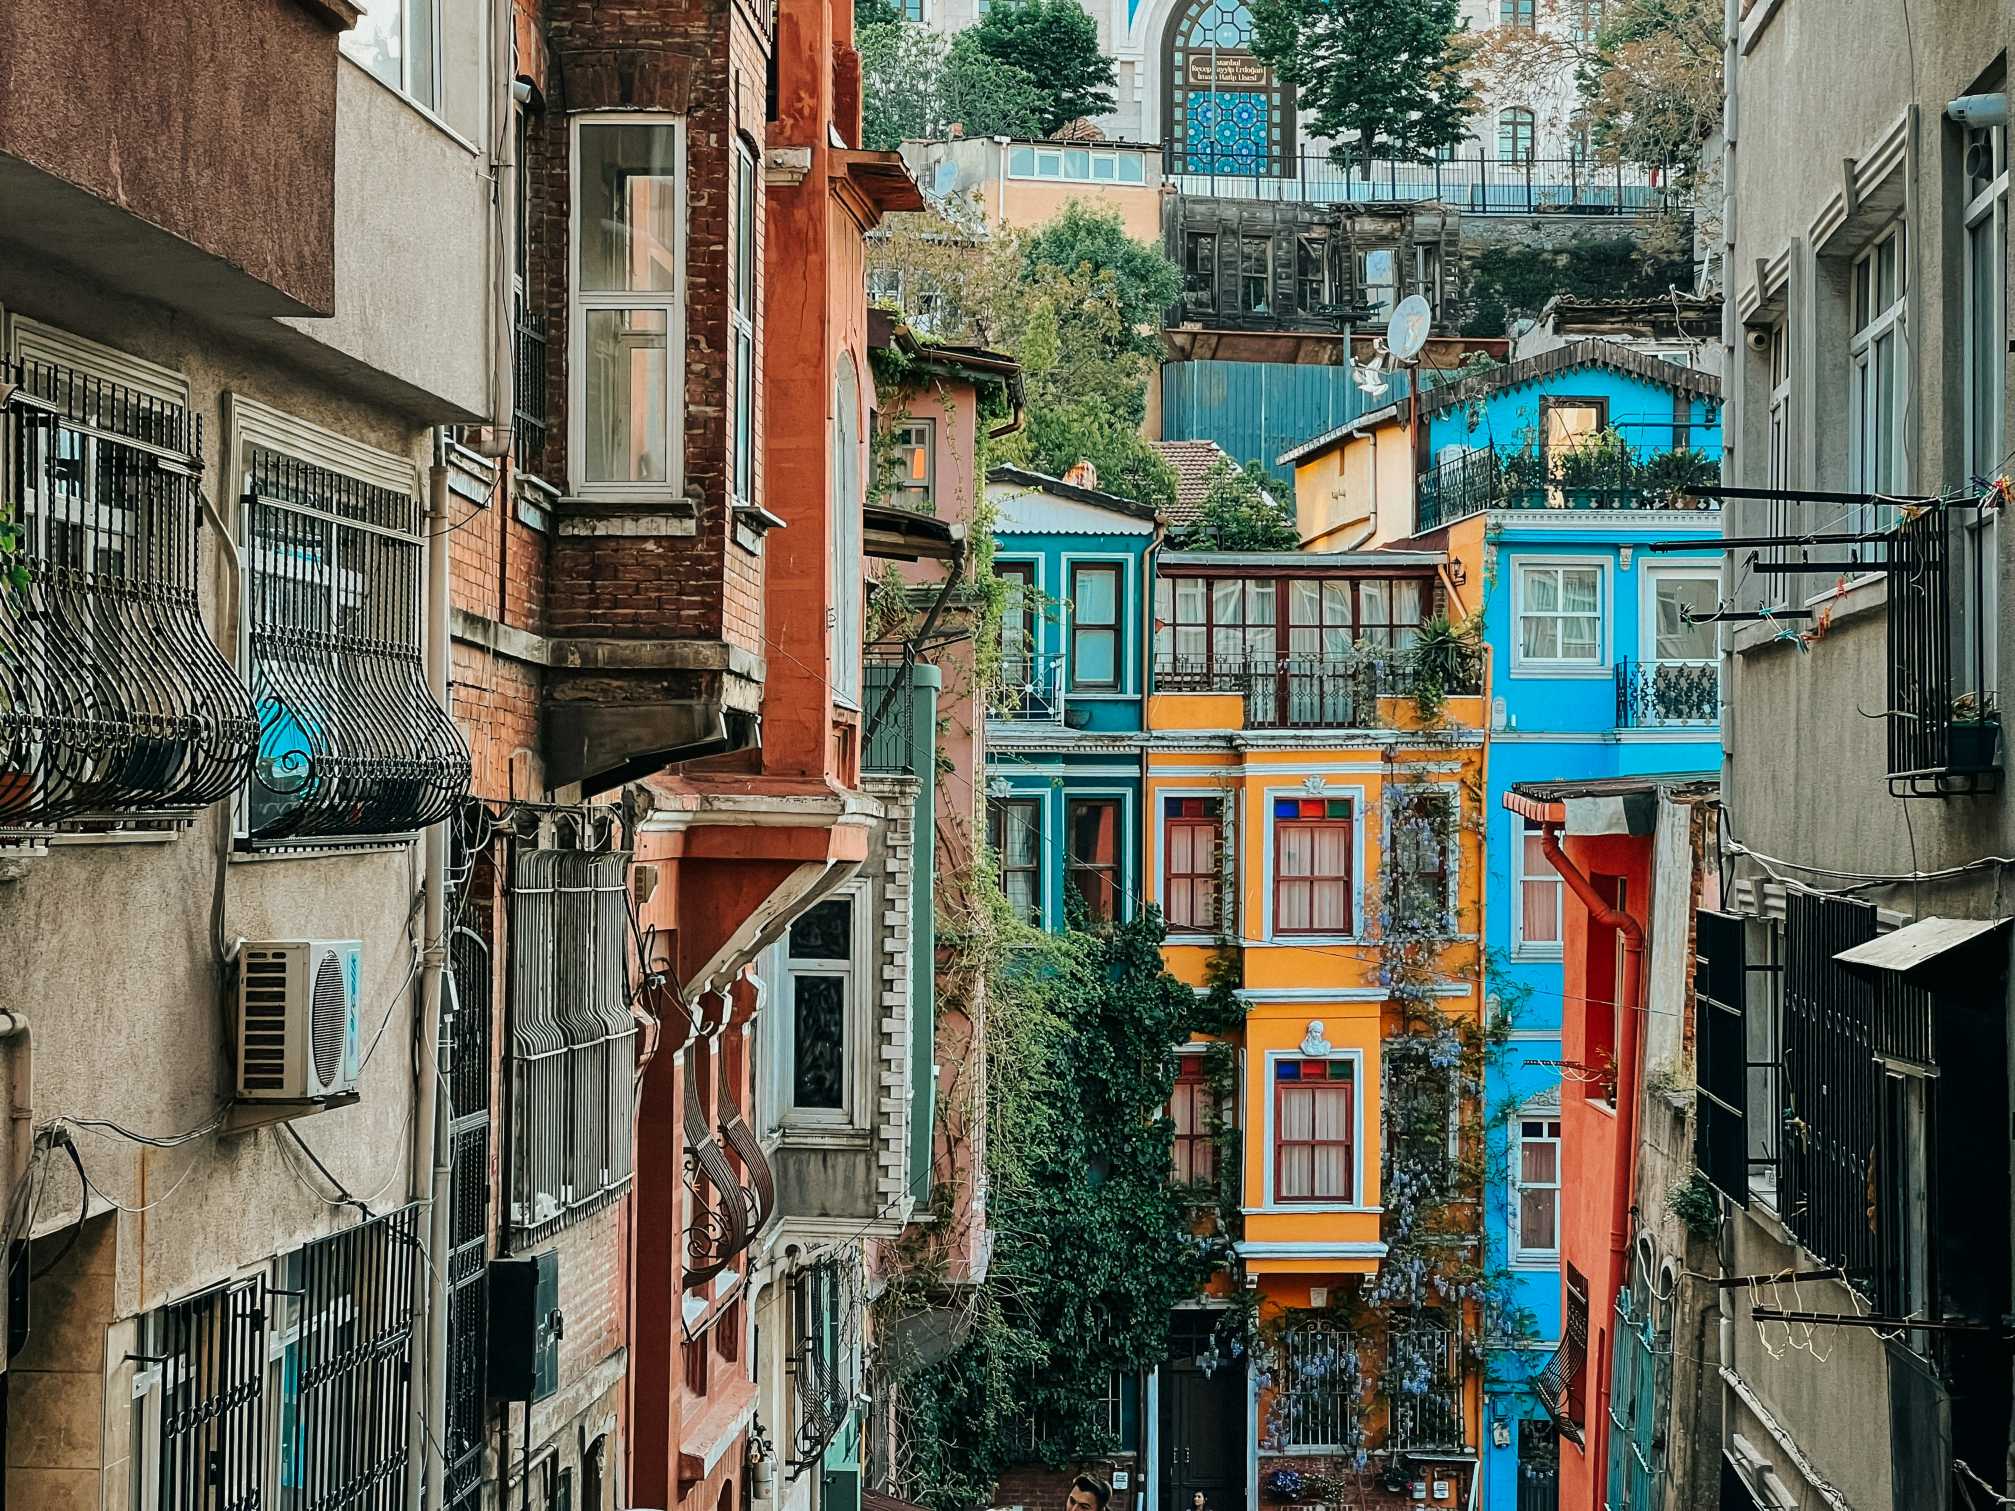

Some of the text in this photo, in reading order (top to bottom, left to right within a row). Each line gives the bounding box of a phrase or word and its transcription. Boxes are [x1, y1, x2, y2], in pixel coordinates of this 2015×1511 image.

[1216, 58, 1241, 66] stanbul
[1191, 64, 1212, 74] Recep
[1216, 65, 1235, 74] ayyip
